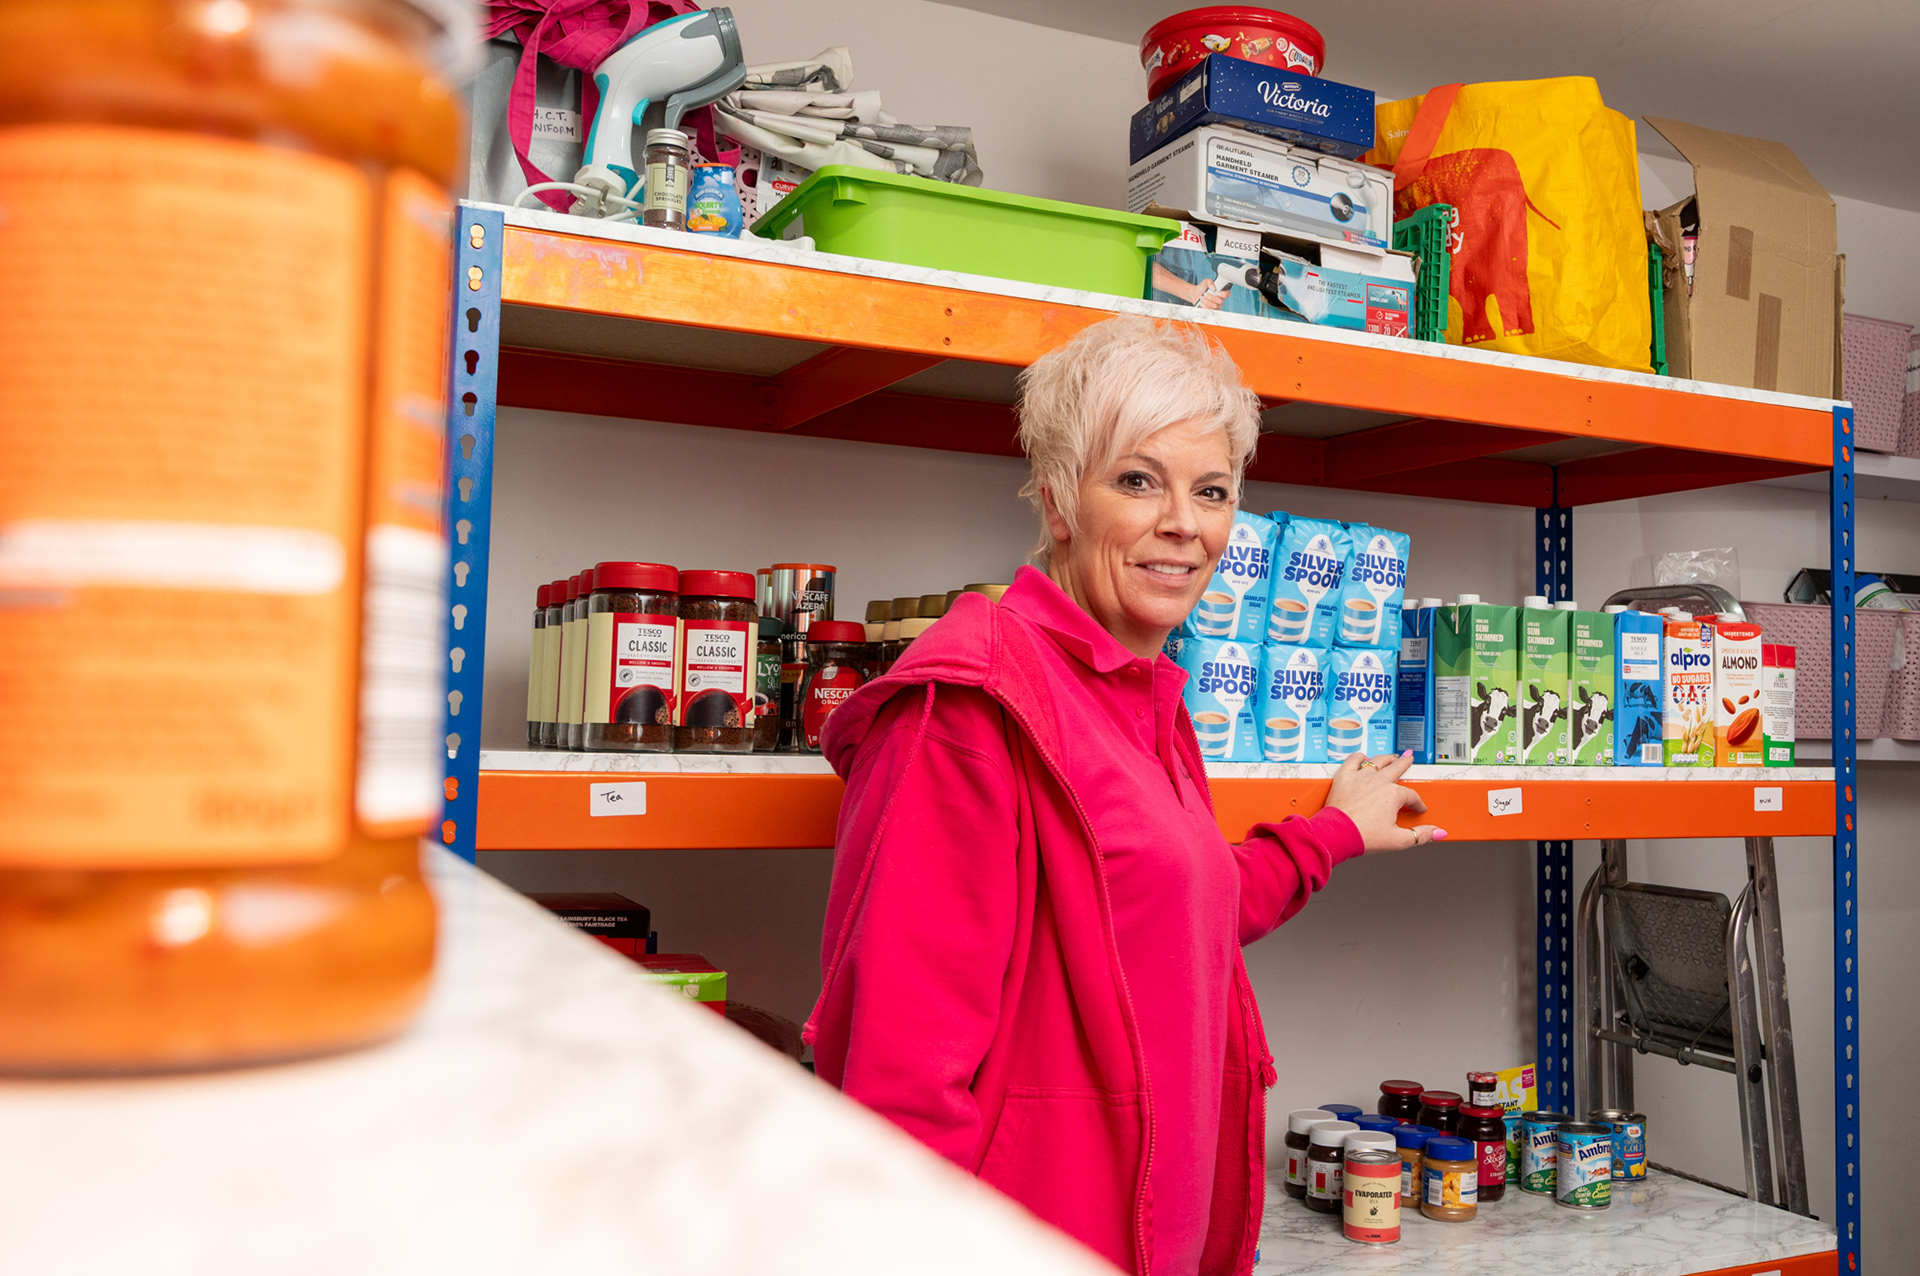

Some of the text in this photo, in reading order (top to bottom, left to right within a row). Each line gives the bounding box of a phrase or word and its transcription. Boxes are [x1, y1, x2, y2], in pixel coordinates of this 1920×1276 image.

[1257, 81, 1331, 117] Victoria
[534, 123, 574, 136] NIFORM
[1387, 128, 1411, 140] Sains
[1128, 140, 1195, 183] HANDHELD GARMENT STEAMER
[1216, 154, 1252, 168] HANDHELD
[1216, 161, 1279, 182] GARMENT STEAMER
[654, 192, 683, 200] CHOCOLATE
[694, 201, 723, 209] SQUIRTY
[1316, 286, 1337, 295] LIGHTEST
[1338, 290, 1362, 298] STEAMER
[1327, 281, 1348, 290] FASTEST
[1368, 324, 1380, 333] 1300
[1222, 545, 1270, 564] ILVER
[1289, 551, 1344, 576] SILVER
[1355, 552, 1406, 575] SILVER
[1283, 566, 1341, 590] SPOON
[1351, 567, 1406, 589] SPOON
[1244, 594, 1266, 603] GRANULATED
[796, 602, 825, 611] AZERA
[637, 628, 662, 636] TESCO
[1475, 624, 1489, 633] SEMI
[1527, 627, 1540, 636] SEMI
[1577, 630, 1590, 638] SEMI
[1475, 633, 1504, 642] SKIMMED
[1527, 636, 1555, 646] SKIMMED
[1577, 639, 1603, 648] SKIMMED
[628, 640, 668, 653] CLASSIC
[696, 645, 736, 658] CLASSIC
[1670, 648, 1711, 671] alpro
[1722, 656, 1758, 669] ALMOND
[1202, 662, 1257, 683] SILVER
[1274, 669, 1324, 686] SILVER
[1672, 674, 1710, 684] NO SUGARS
[1338, 672, 1392, 689] SILVER
[1270, 685, 1324, 701] SPOON
[1334, 687, 1392, 703] SPOON
[1673, 685, 1710, 705] OAT
[600, 790, 624, 803] Tea
[1355, 1189, 1392, 1198] EVAPORATED
